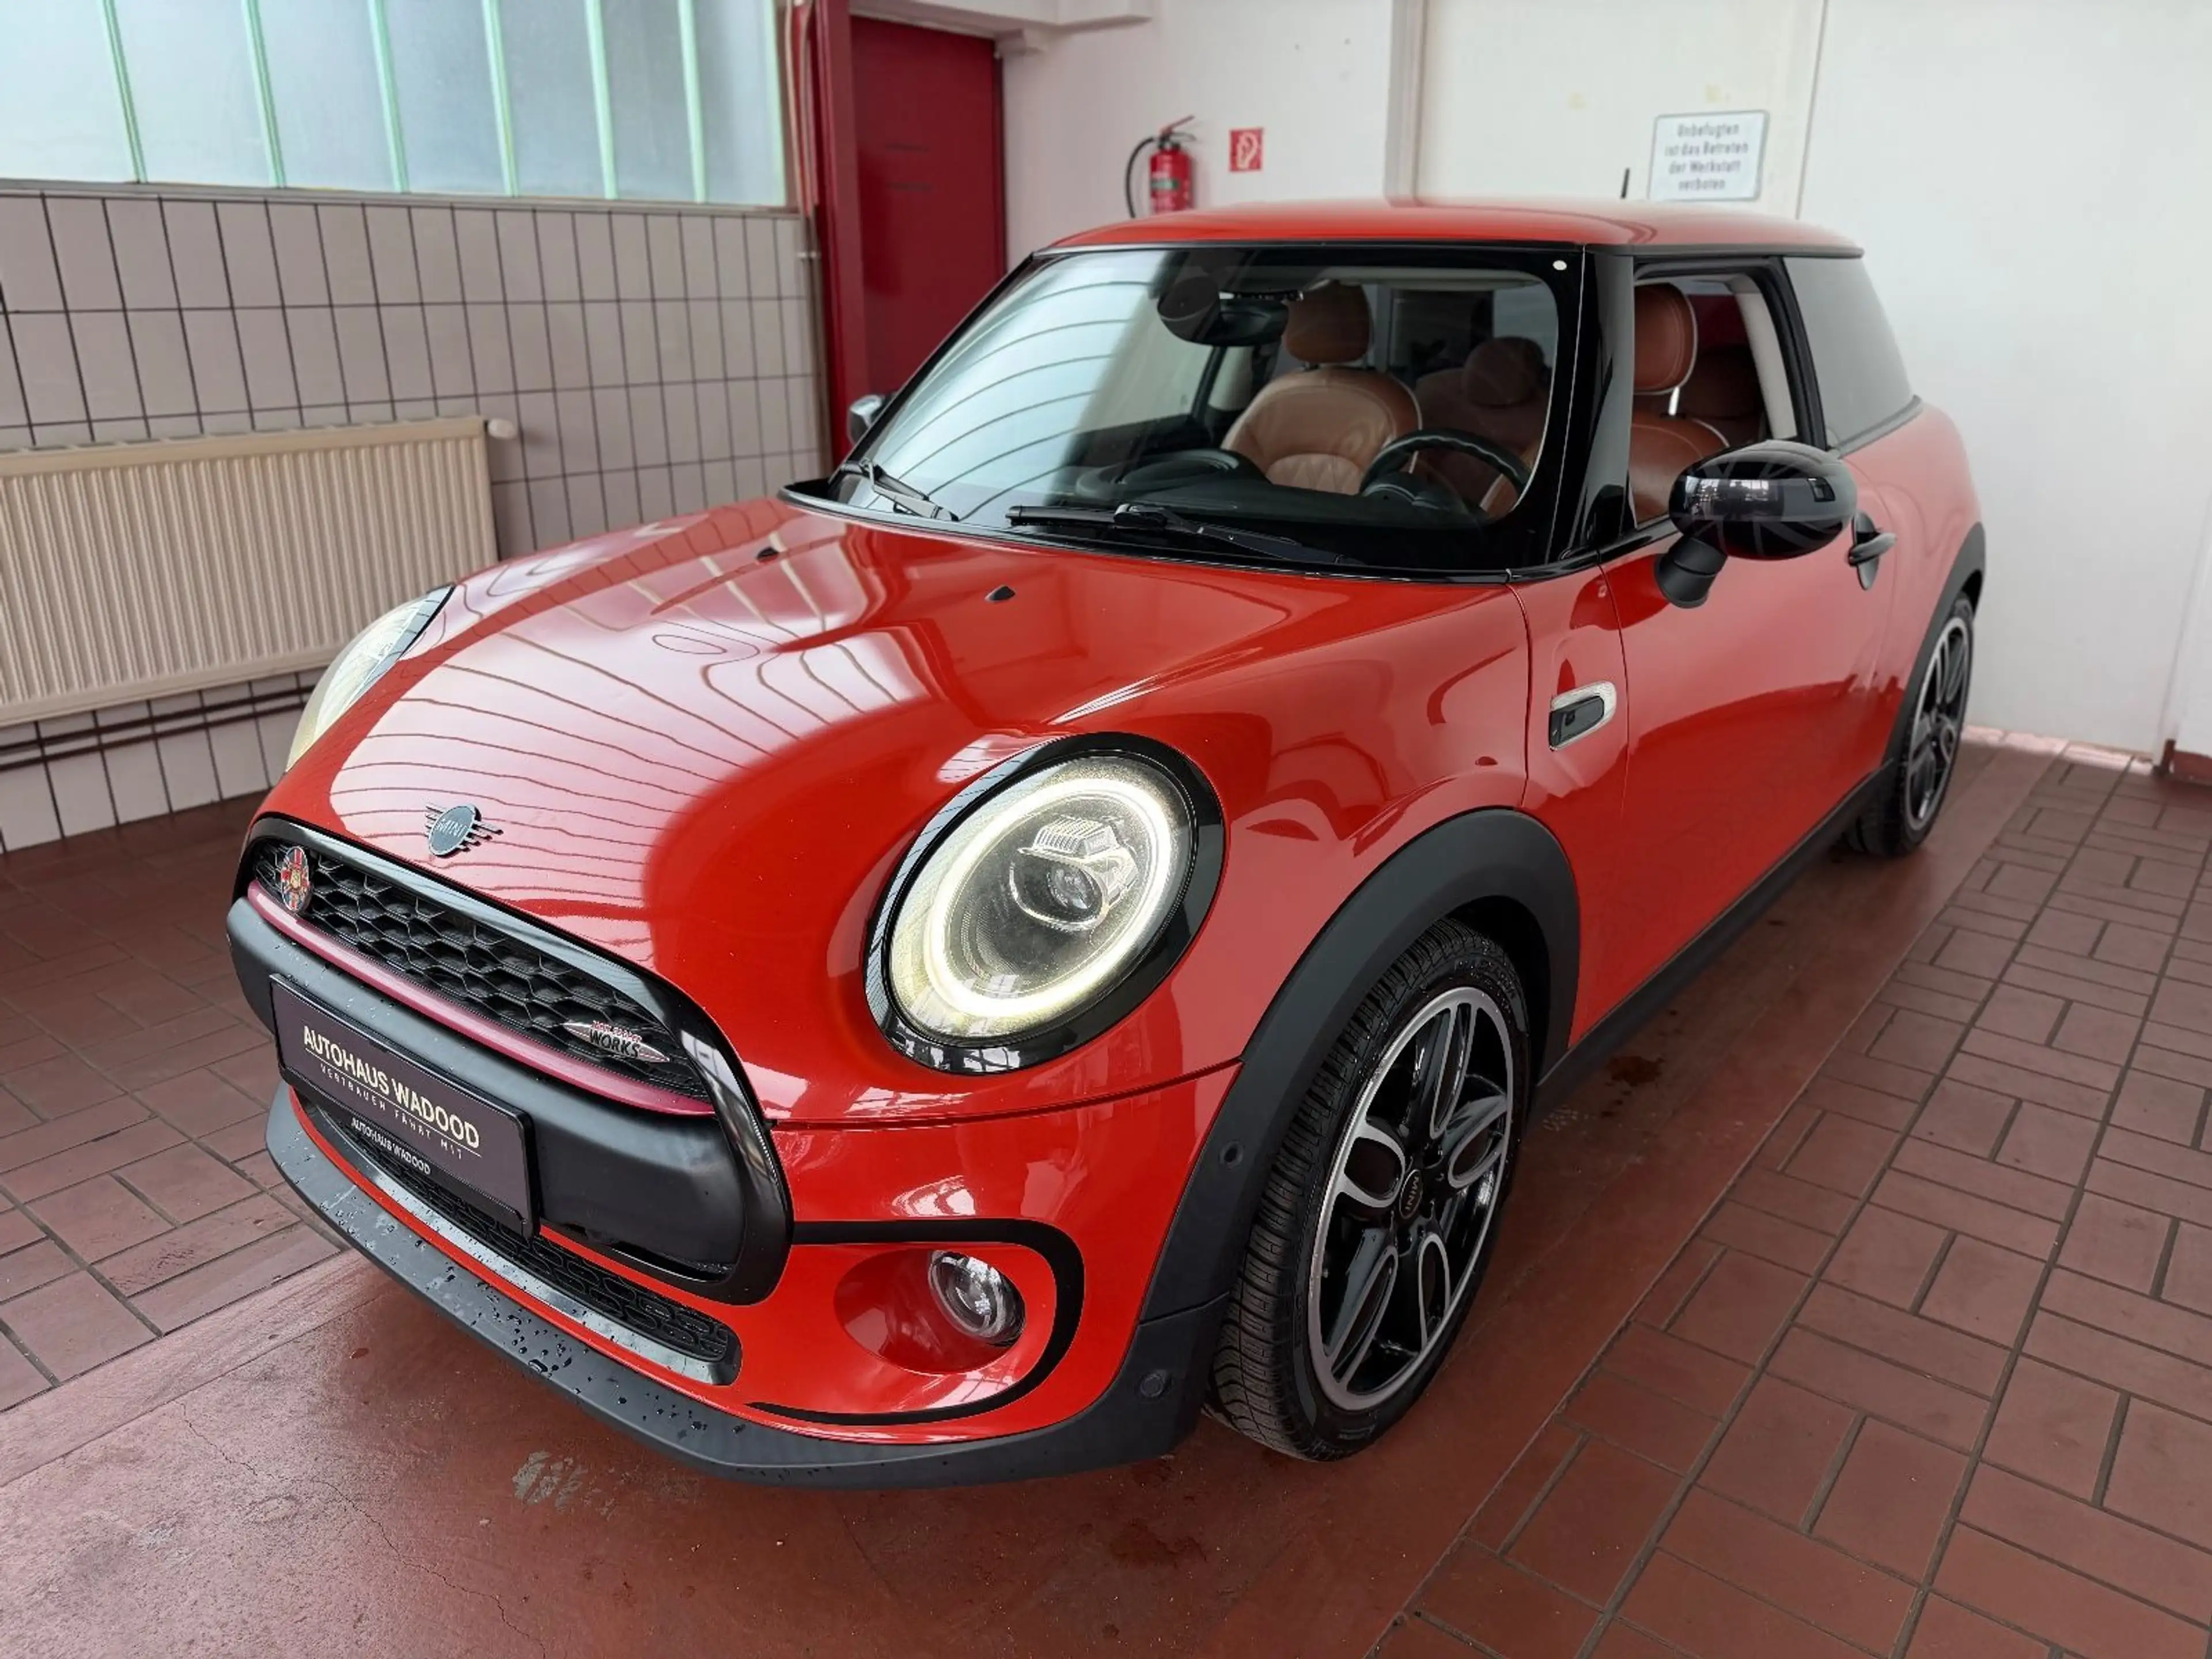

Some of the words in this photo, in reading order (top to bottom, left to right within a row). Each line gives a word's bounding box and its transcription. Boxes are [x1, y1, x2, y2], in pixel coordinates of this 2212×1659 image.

[436, 818, 468, 838] MINI
[590, 1028, 641, 1059] WORKS
[304, 1025, 389, 1095] AUTOHAUS
[391, 1078, 479, 1149] WADOOD
[320, 1063, 385, 1111] VERTRAUEN
[441, 1139, 461, 1160] MIT
[351, 1117, 392, 1152] AUTOHAUS
[392, 1143, 431, 1175] WADOOD
[1405, 1176, 1419, 1210] MINI
